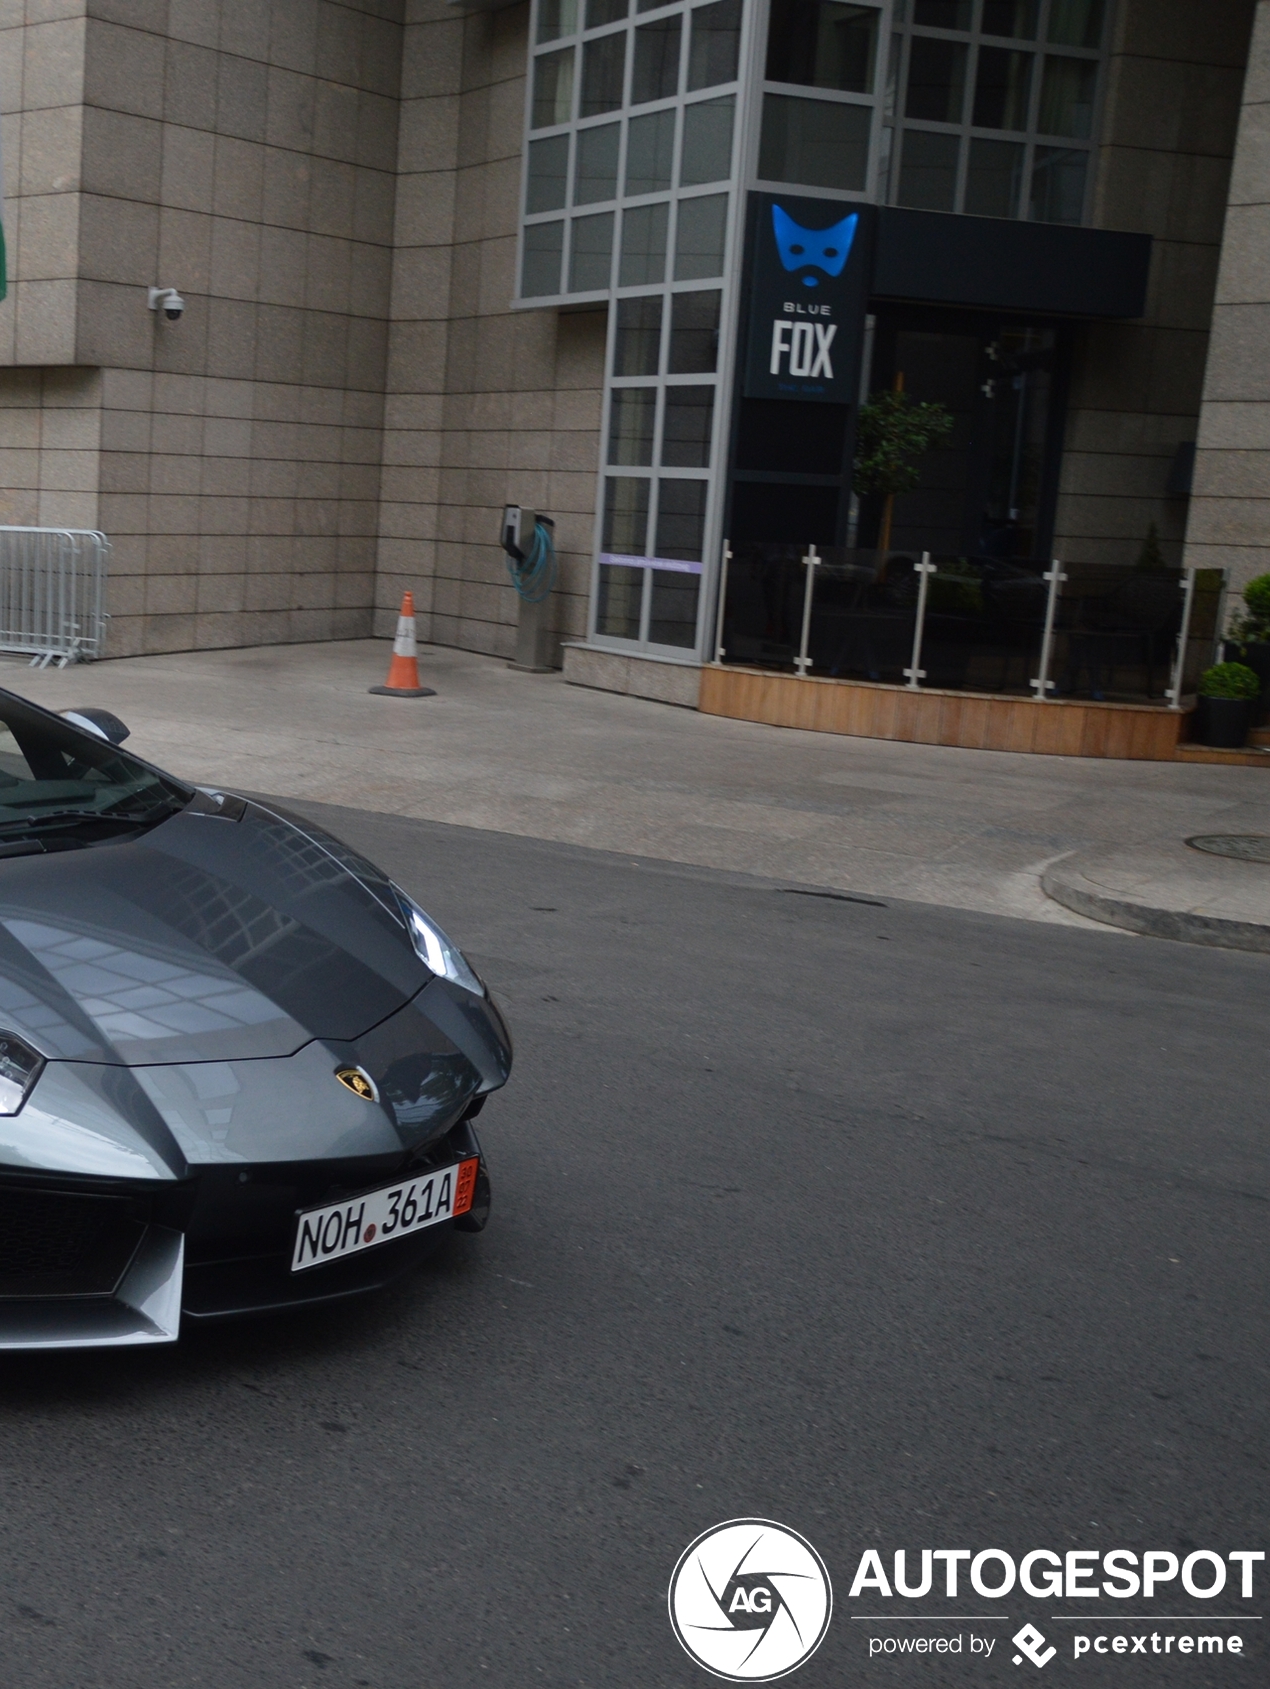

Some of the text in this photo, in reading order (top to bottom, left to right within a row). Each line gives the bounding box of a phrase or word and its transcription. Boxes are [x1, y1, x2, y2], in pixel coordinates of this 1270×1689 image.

[783, 301, 832, 316] BLUE
[769, 319, 838, 379] FOX
[461, 1165, 473, 1180] 30
[297, 1172, 452, 1263] NOH 361A
